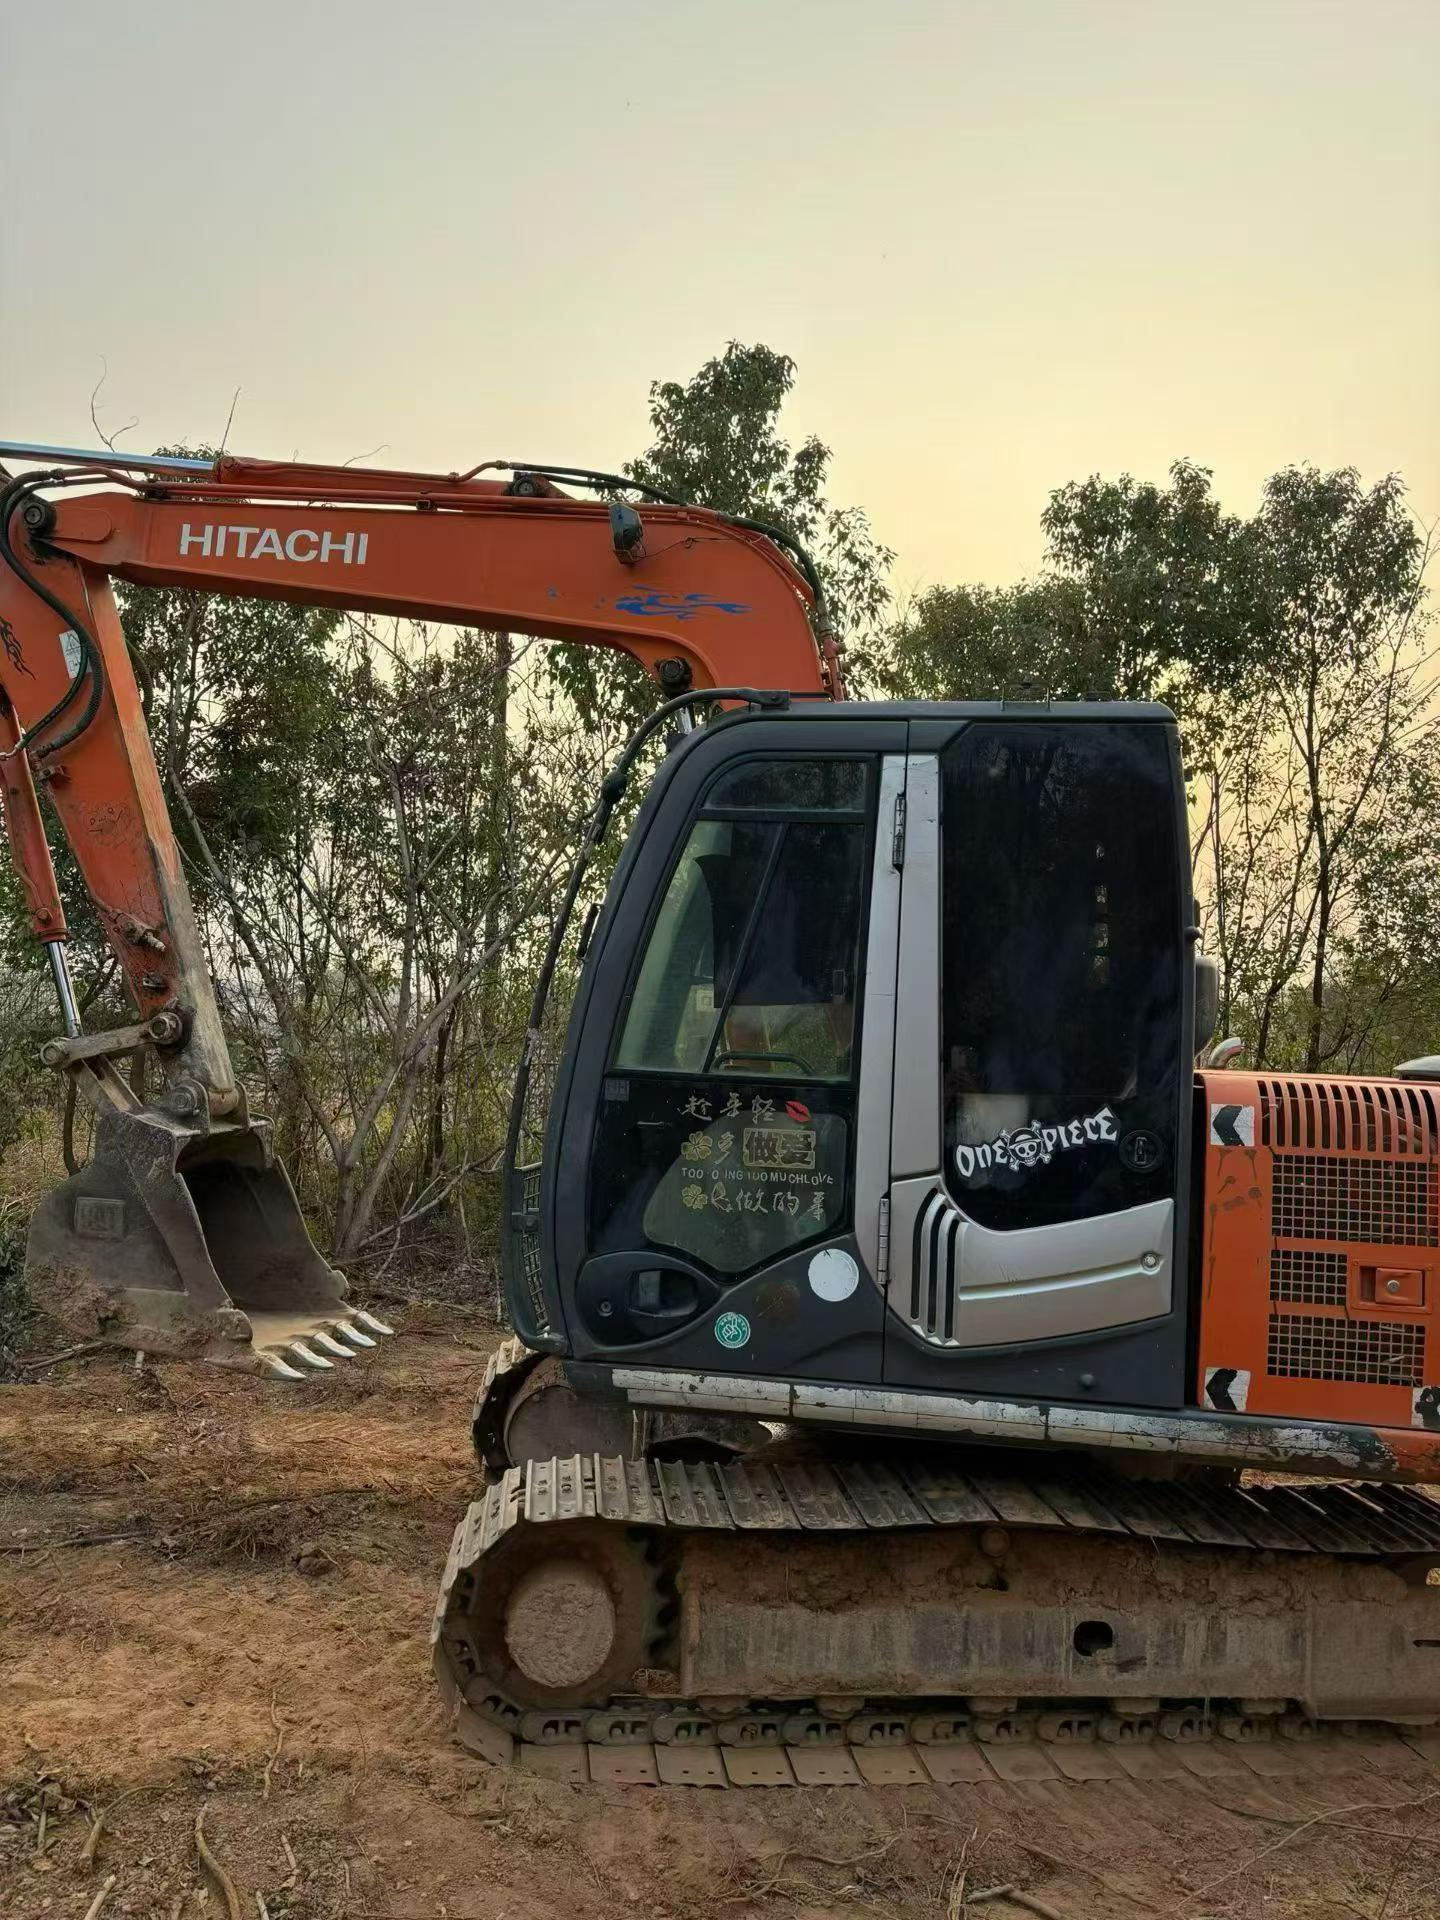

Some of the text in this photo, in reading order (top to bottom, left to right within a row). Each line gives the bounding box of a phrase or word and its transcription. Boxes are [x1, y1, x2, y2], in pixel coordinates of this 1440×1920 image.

[179, 523, 369, 565] HITACHI
[1041, 1106, 1119, 1153] PIECE
[681, 1167, 704, 1179] TOO
